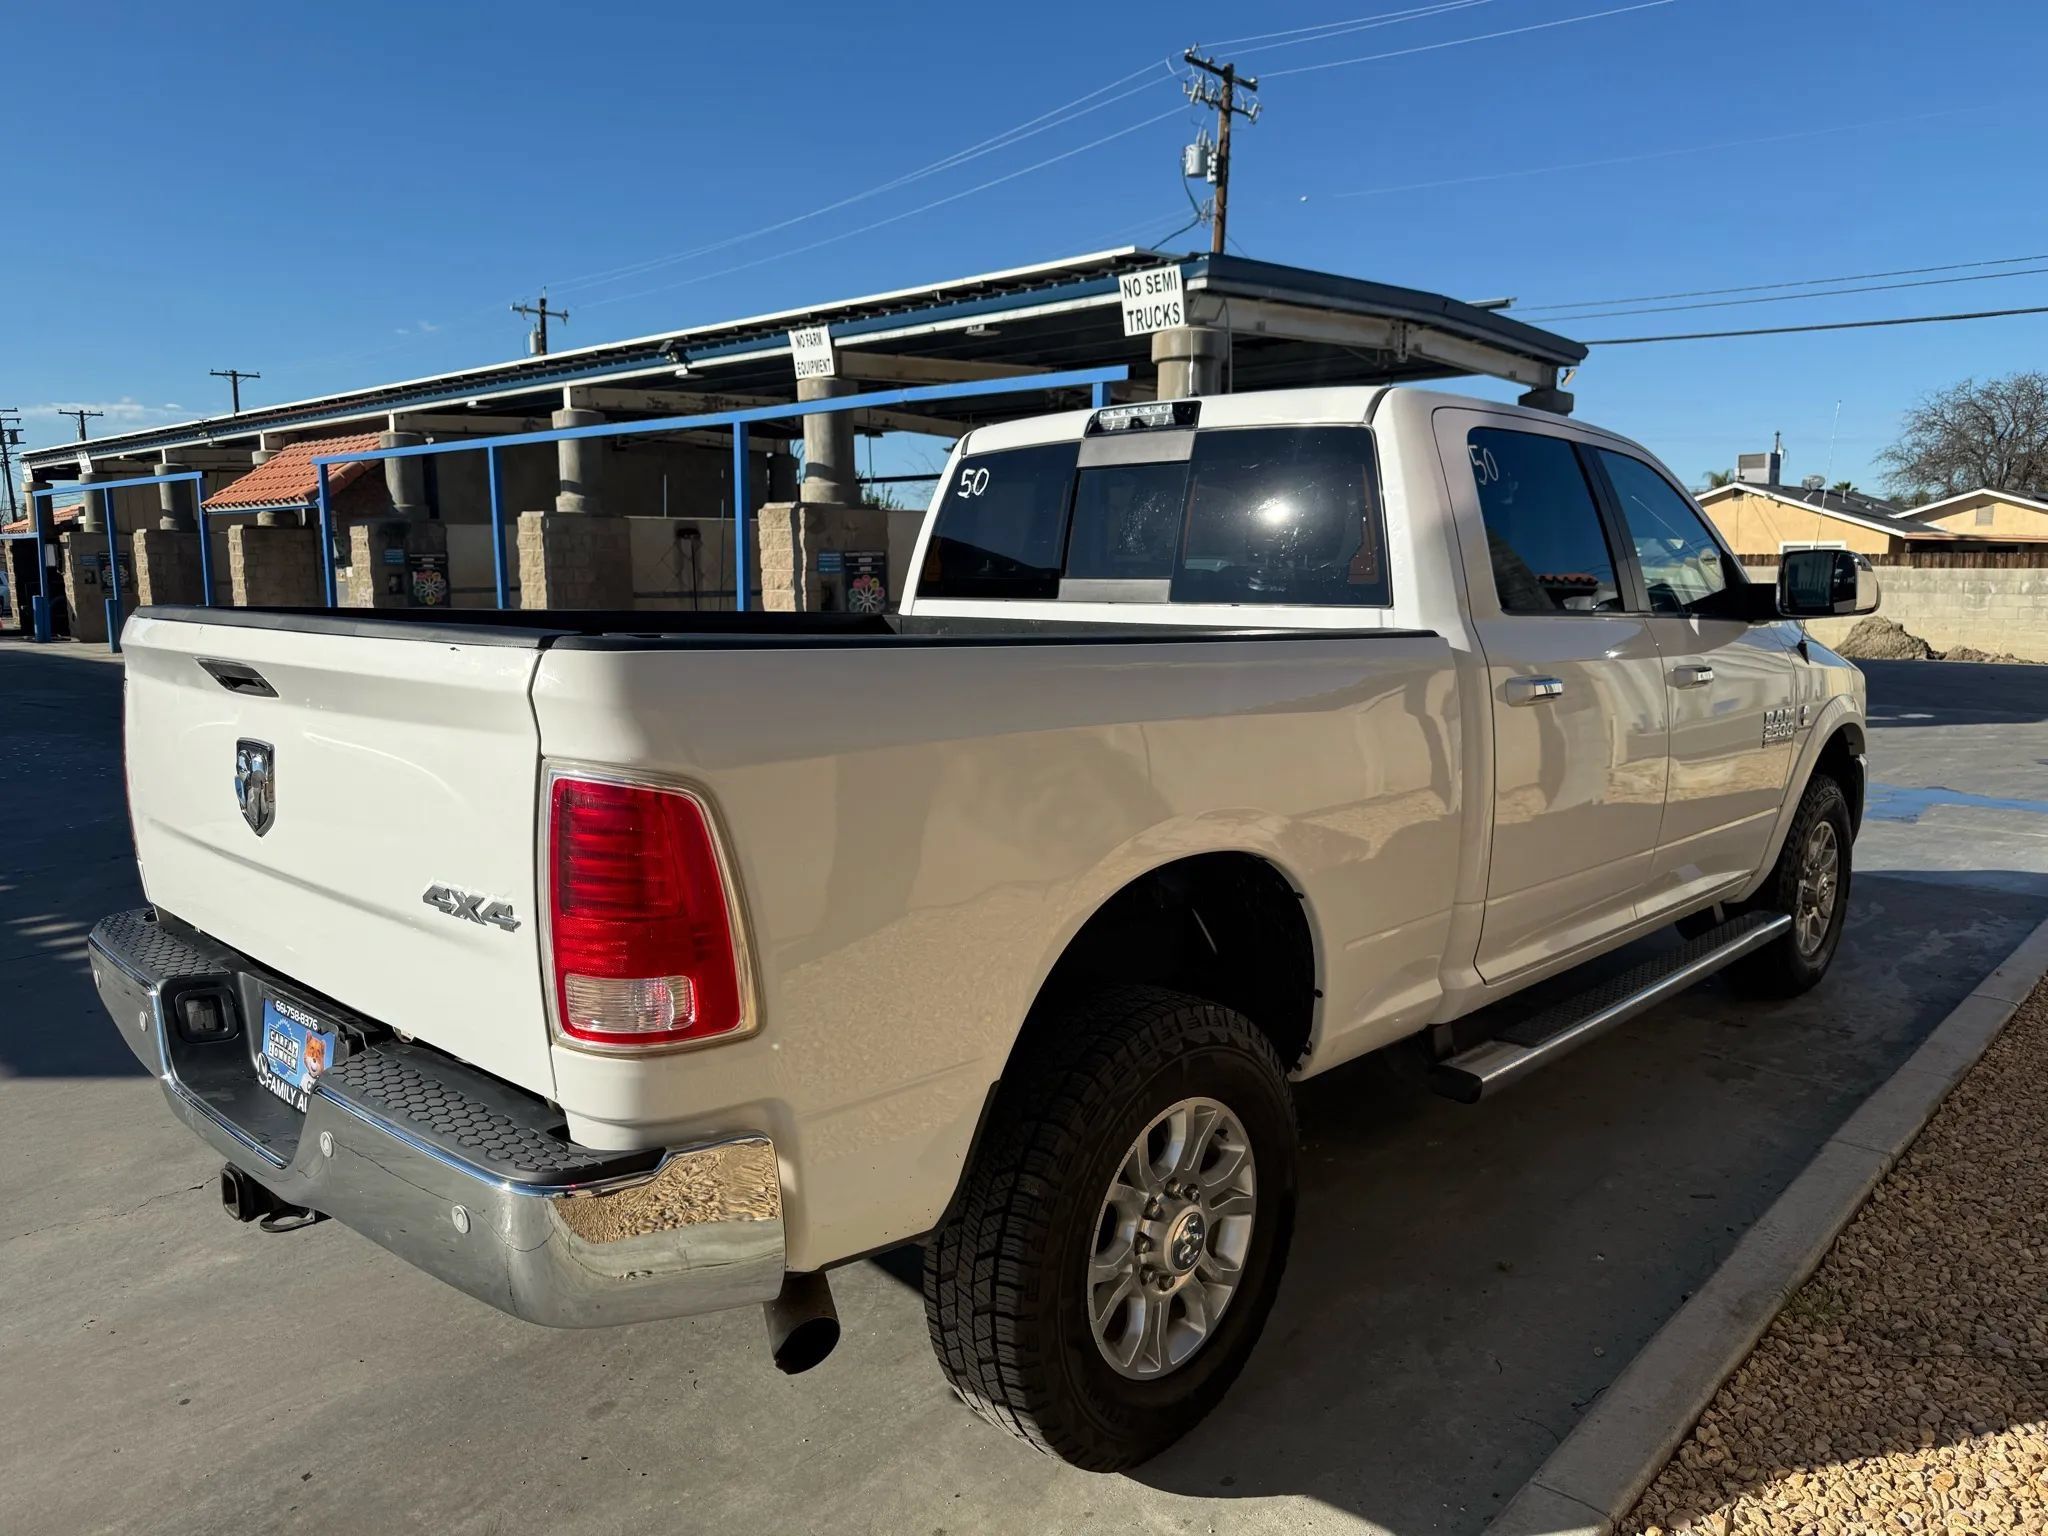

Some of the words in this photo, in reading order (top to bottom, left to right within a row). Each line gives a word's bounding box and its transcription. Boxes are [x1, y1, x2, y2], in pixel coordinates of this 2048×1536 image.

[1123, 278, 1141, 299] NO
[1145, 270, 1177, 294] SEMI
[1127, 302, 1180, 332] TRUCKS
[795, 333, 805, 349] NO
[806, 331, 823, 348] FARM
[797, 358, 831, 375] EQUIPMENT
[1468, 444, 1499, 485] 50
[957, 467, 990, 499] 50
[275, 1000, 318, 1031] 661-758-8376
[270, 1029, 298, 1058] CARFAX
[265, 1072, 297, 1106] FAMILY
